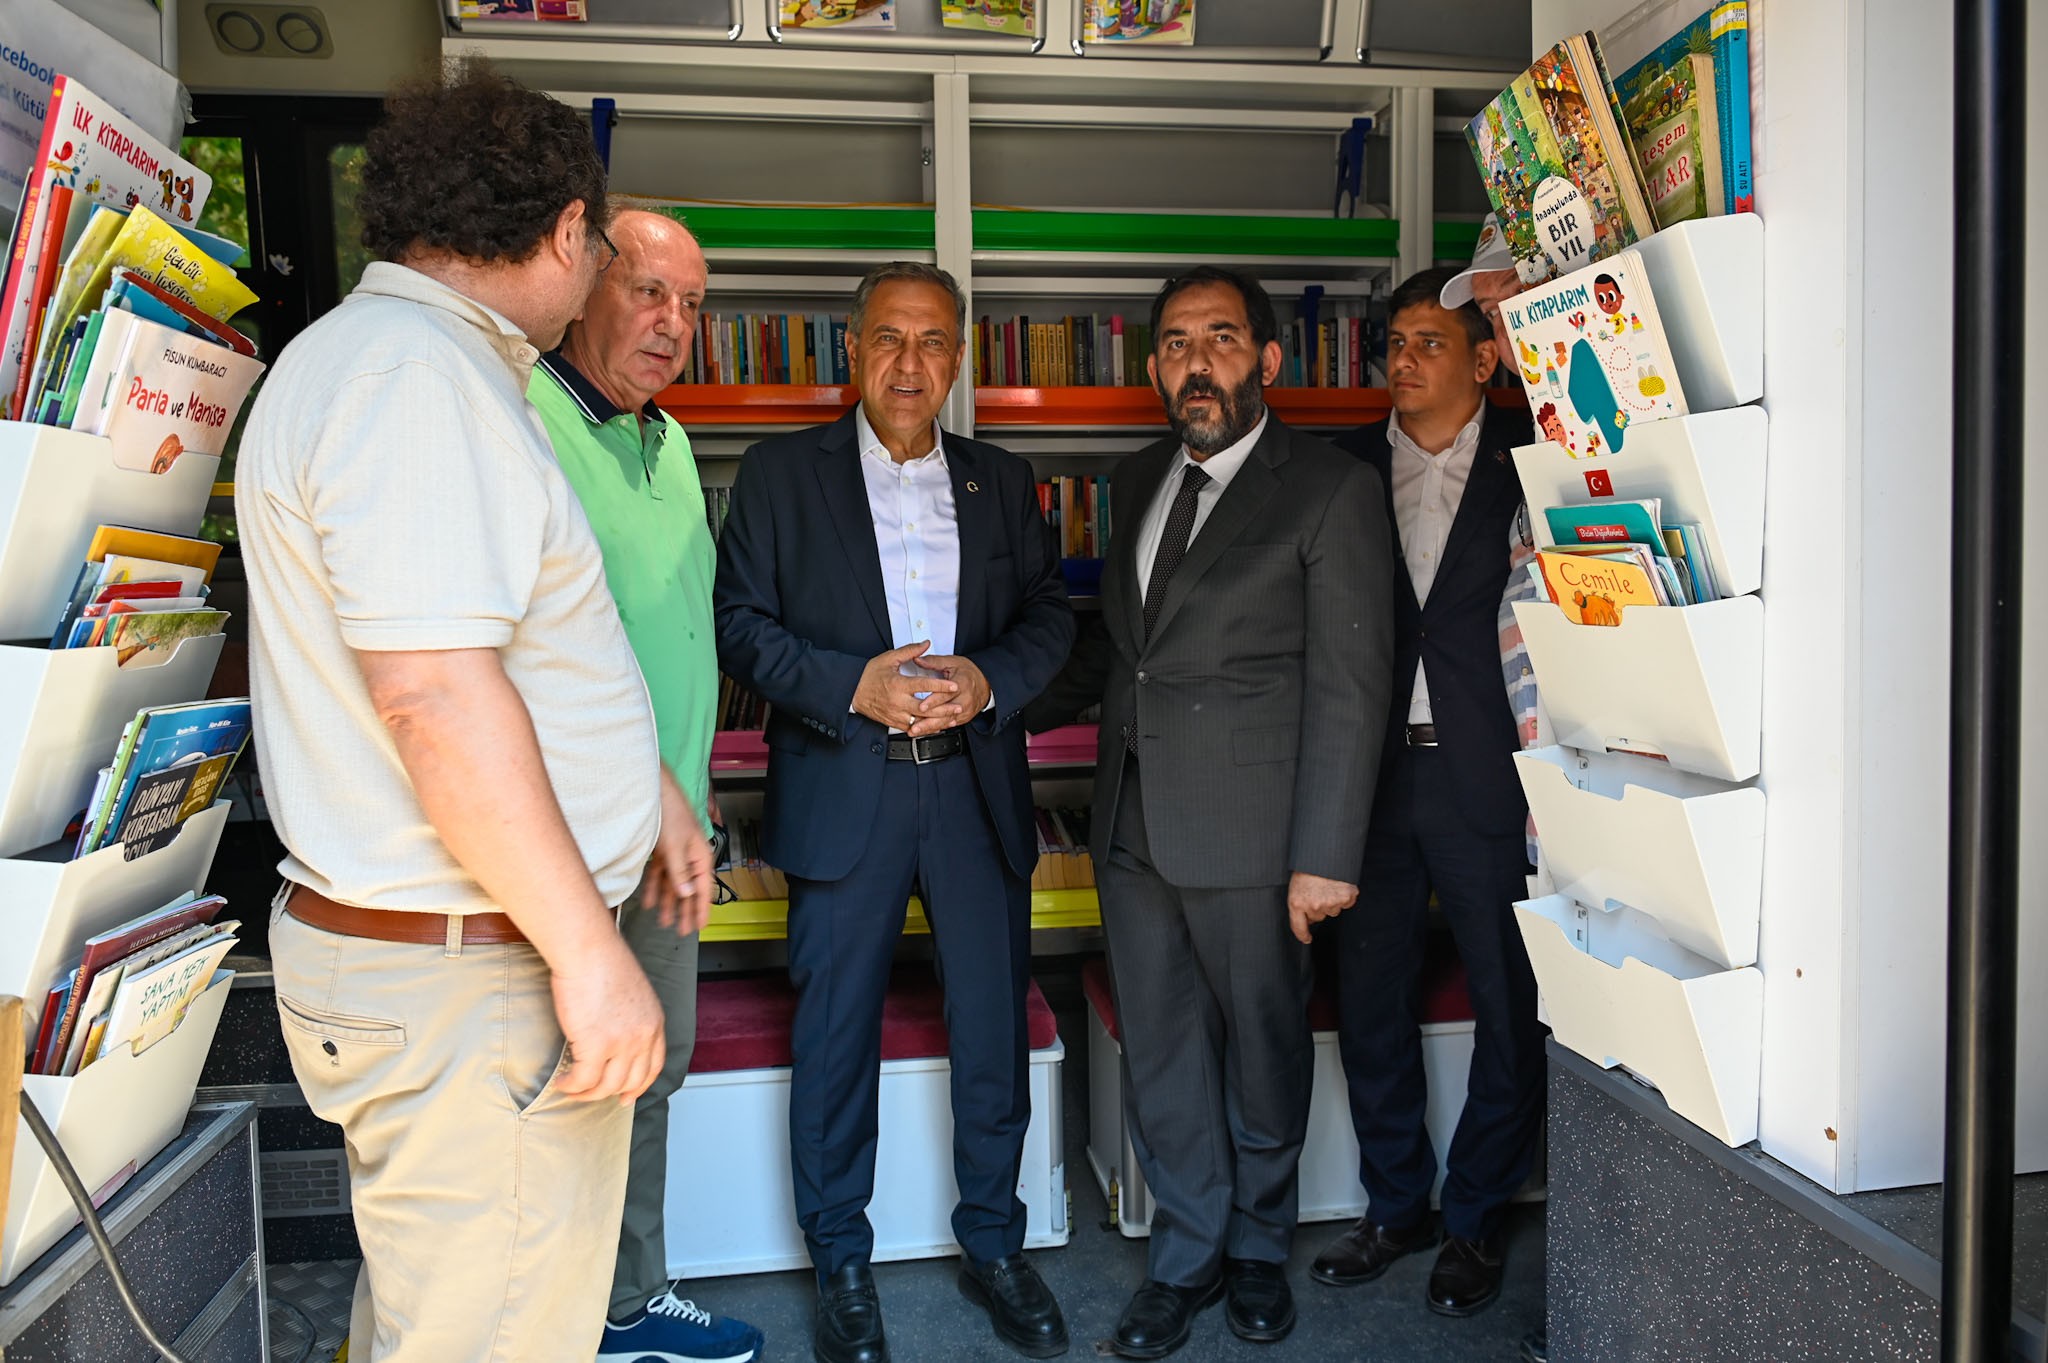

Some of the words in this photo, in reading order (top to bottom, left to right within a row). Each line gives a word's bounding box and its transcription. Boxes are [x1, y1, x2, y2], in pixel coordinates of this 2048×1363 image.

[0, 43, 56, 86] cebook
[72, 101, 94, 136] İLK
[96, 121, 159, 180] KİTAPLARIM
[1738, 161, 1748, 177] ALTI
[1739, 180, 1748, 190] SU
[1535, 190, 1578, 222] Anaokulunda
[1548, 213, 1578, 243] BİR
[1558, 236, 1586, 262] YIL
[1507, 310, 1525, 331] İLK
[1526, 284, 1590, 325] KİTAPLARIM
[187, 354, 228, 378] KUMBARACI
[127, 376, 169, 415] Parla
[171, 401, 184, 418] ve
[185, 391, 227, 427] Manisa
[1560, 562, 1634, 594] Cemile
[132, 778, 186, 816] DÜNYAYI
[120, 803, 184, 844] KURTARAN
[140, 972, 176, 1005] SANA
[178, 956, 210, 982] KEK
[141, 981, 190, 1027] YAPTIM
